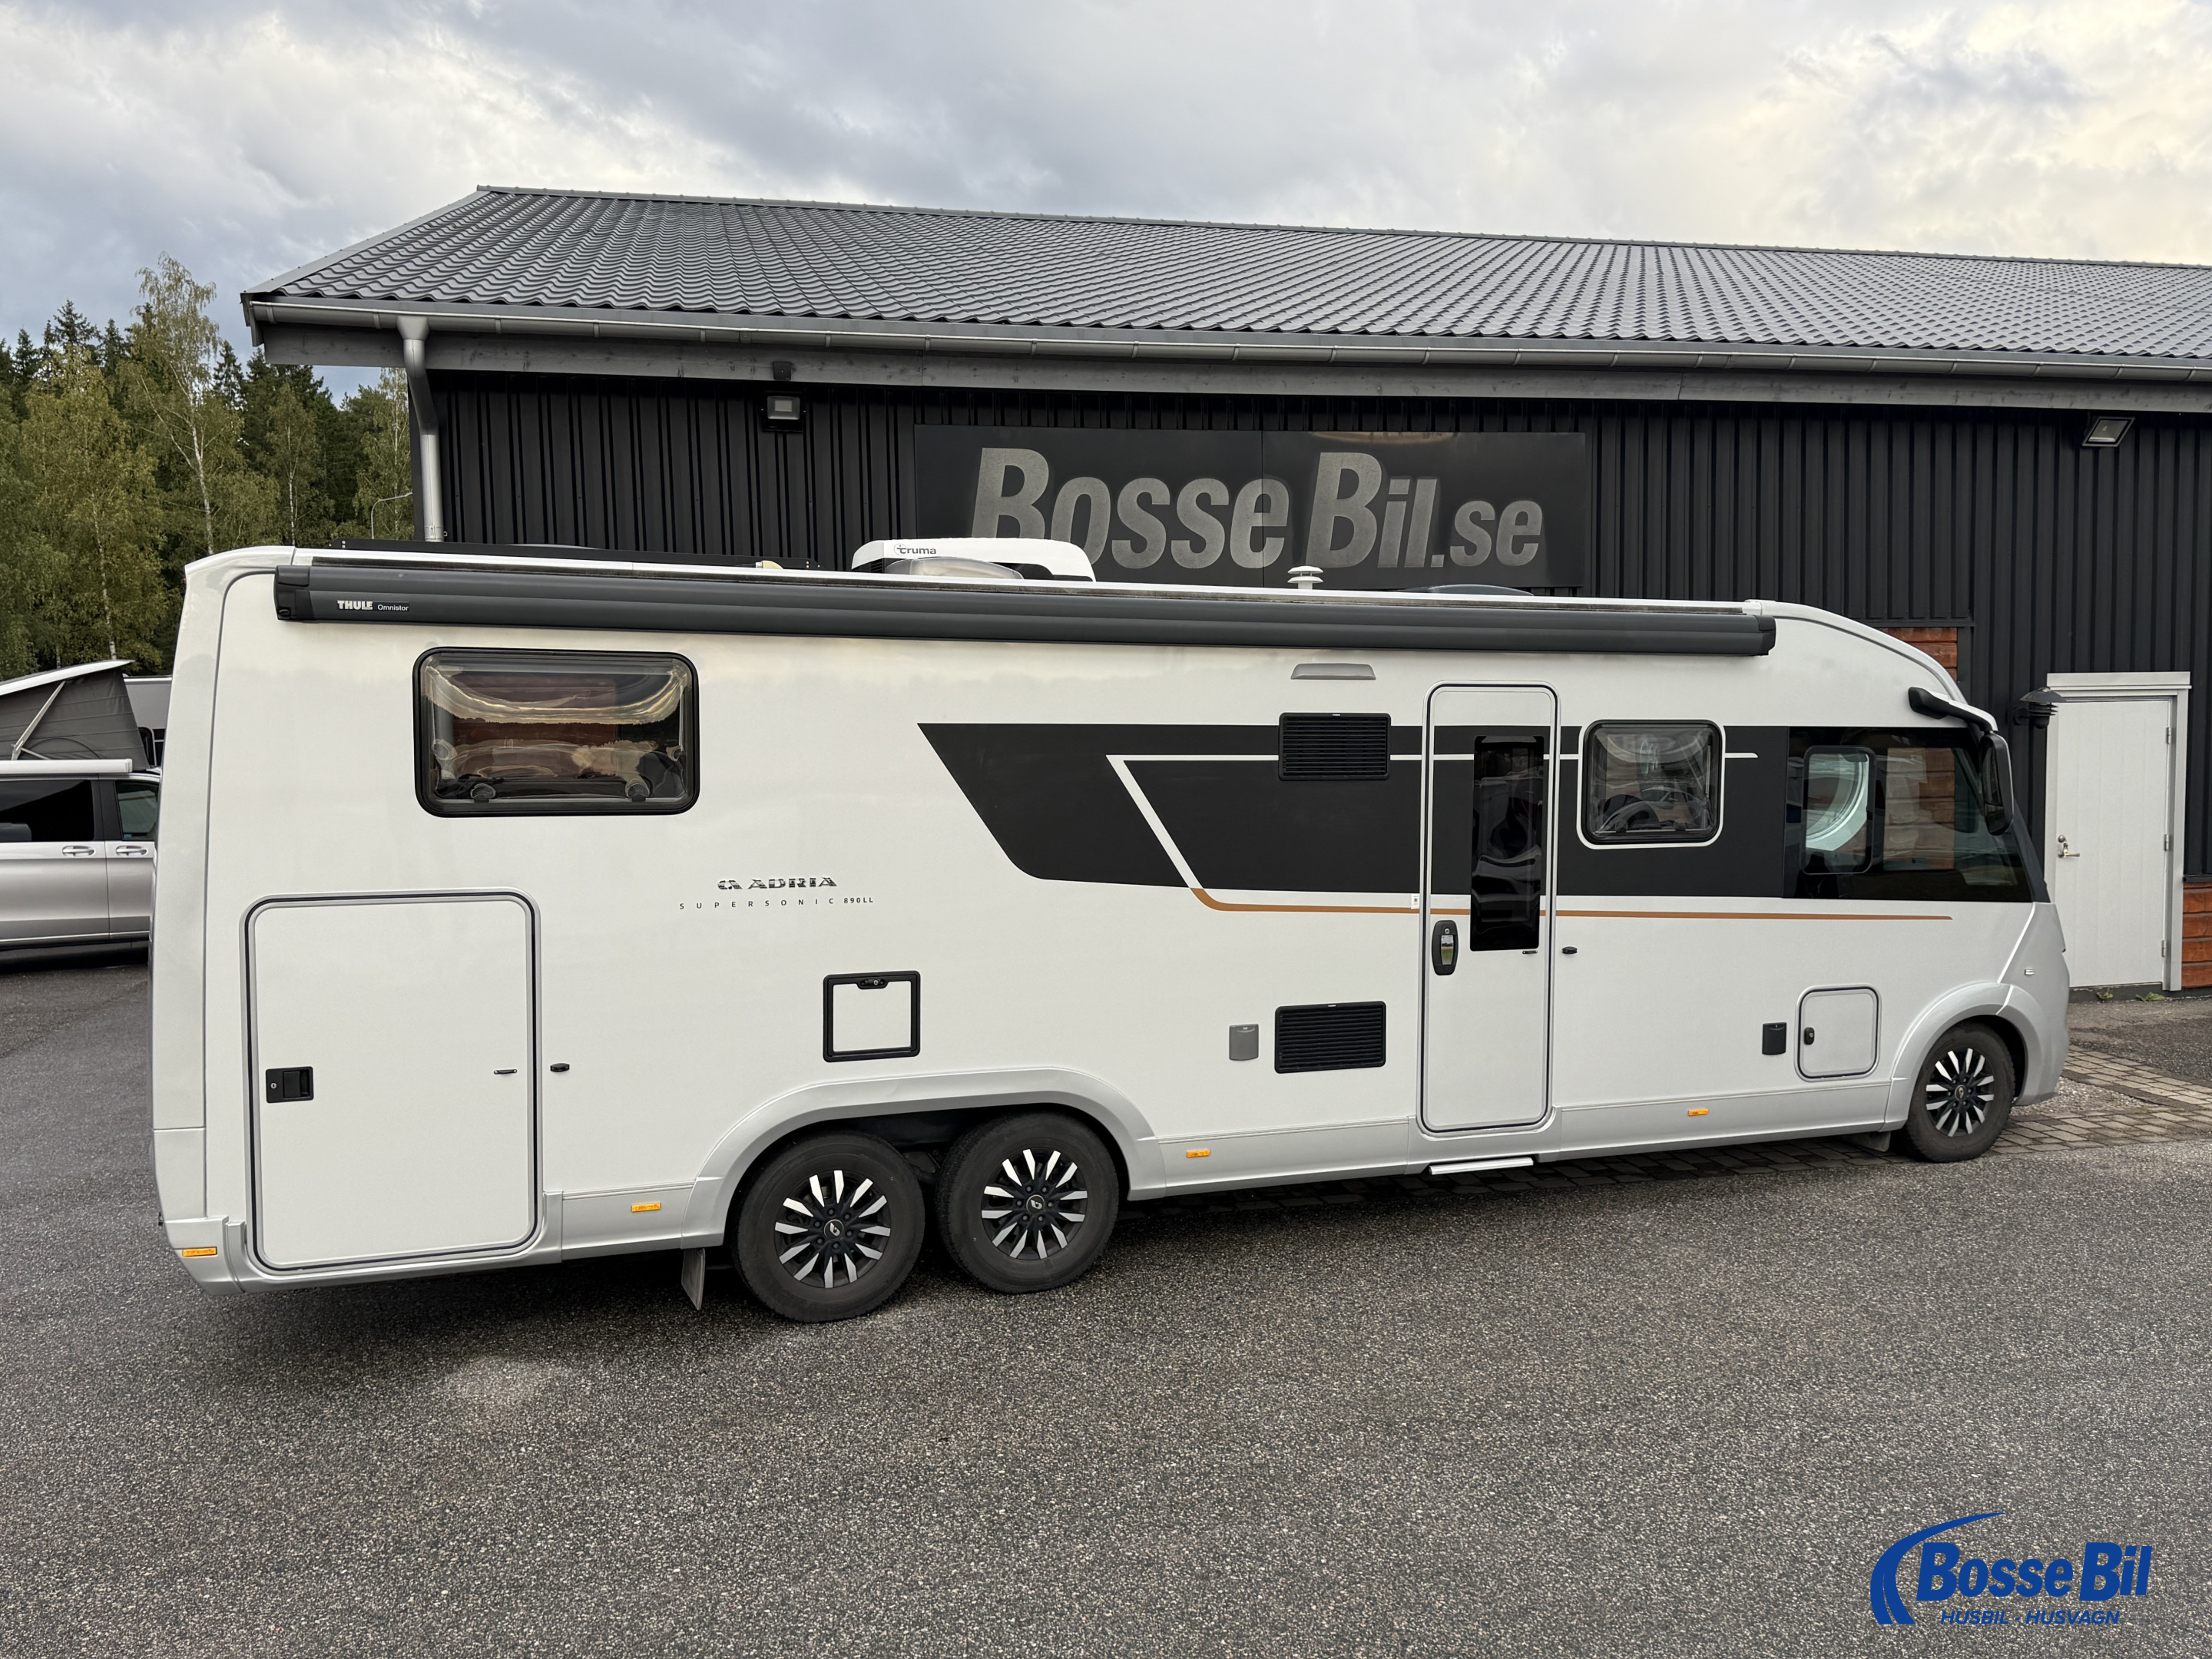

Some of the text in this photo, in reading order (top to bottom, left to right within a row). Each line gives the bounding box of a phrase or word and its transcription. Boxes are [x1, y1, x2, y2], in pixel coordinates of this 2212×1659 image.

[972, 447, 1543, 569] Bosse Bil.se
[896, 546, 937, 555] truma
[337, 600, 409, 612] THULE Omnistor
[747, 877, 837, 890] ADRIA
[679, 897, 834, 909] SUPERSONIC
